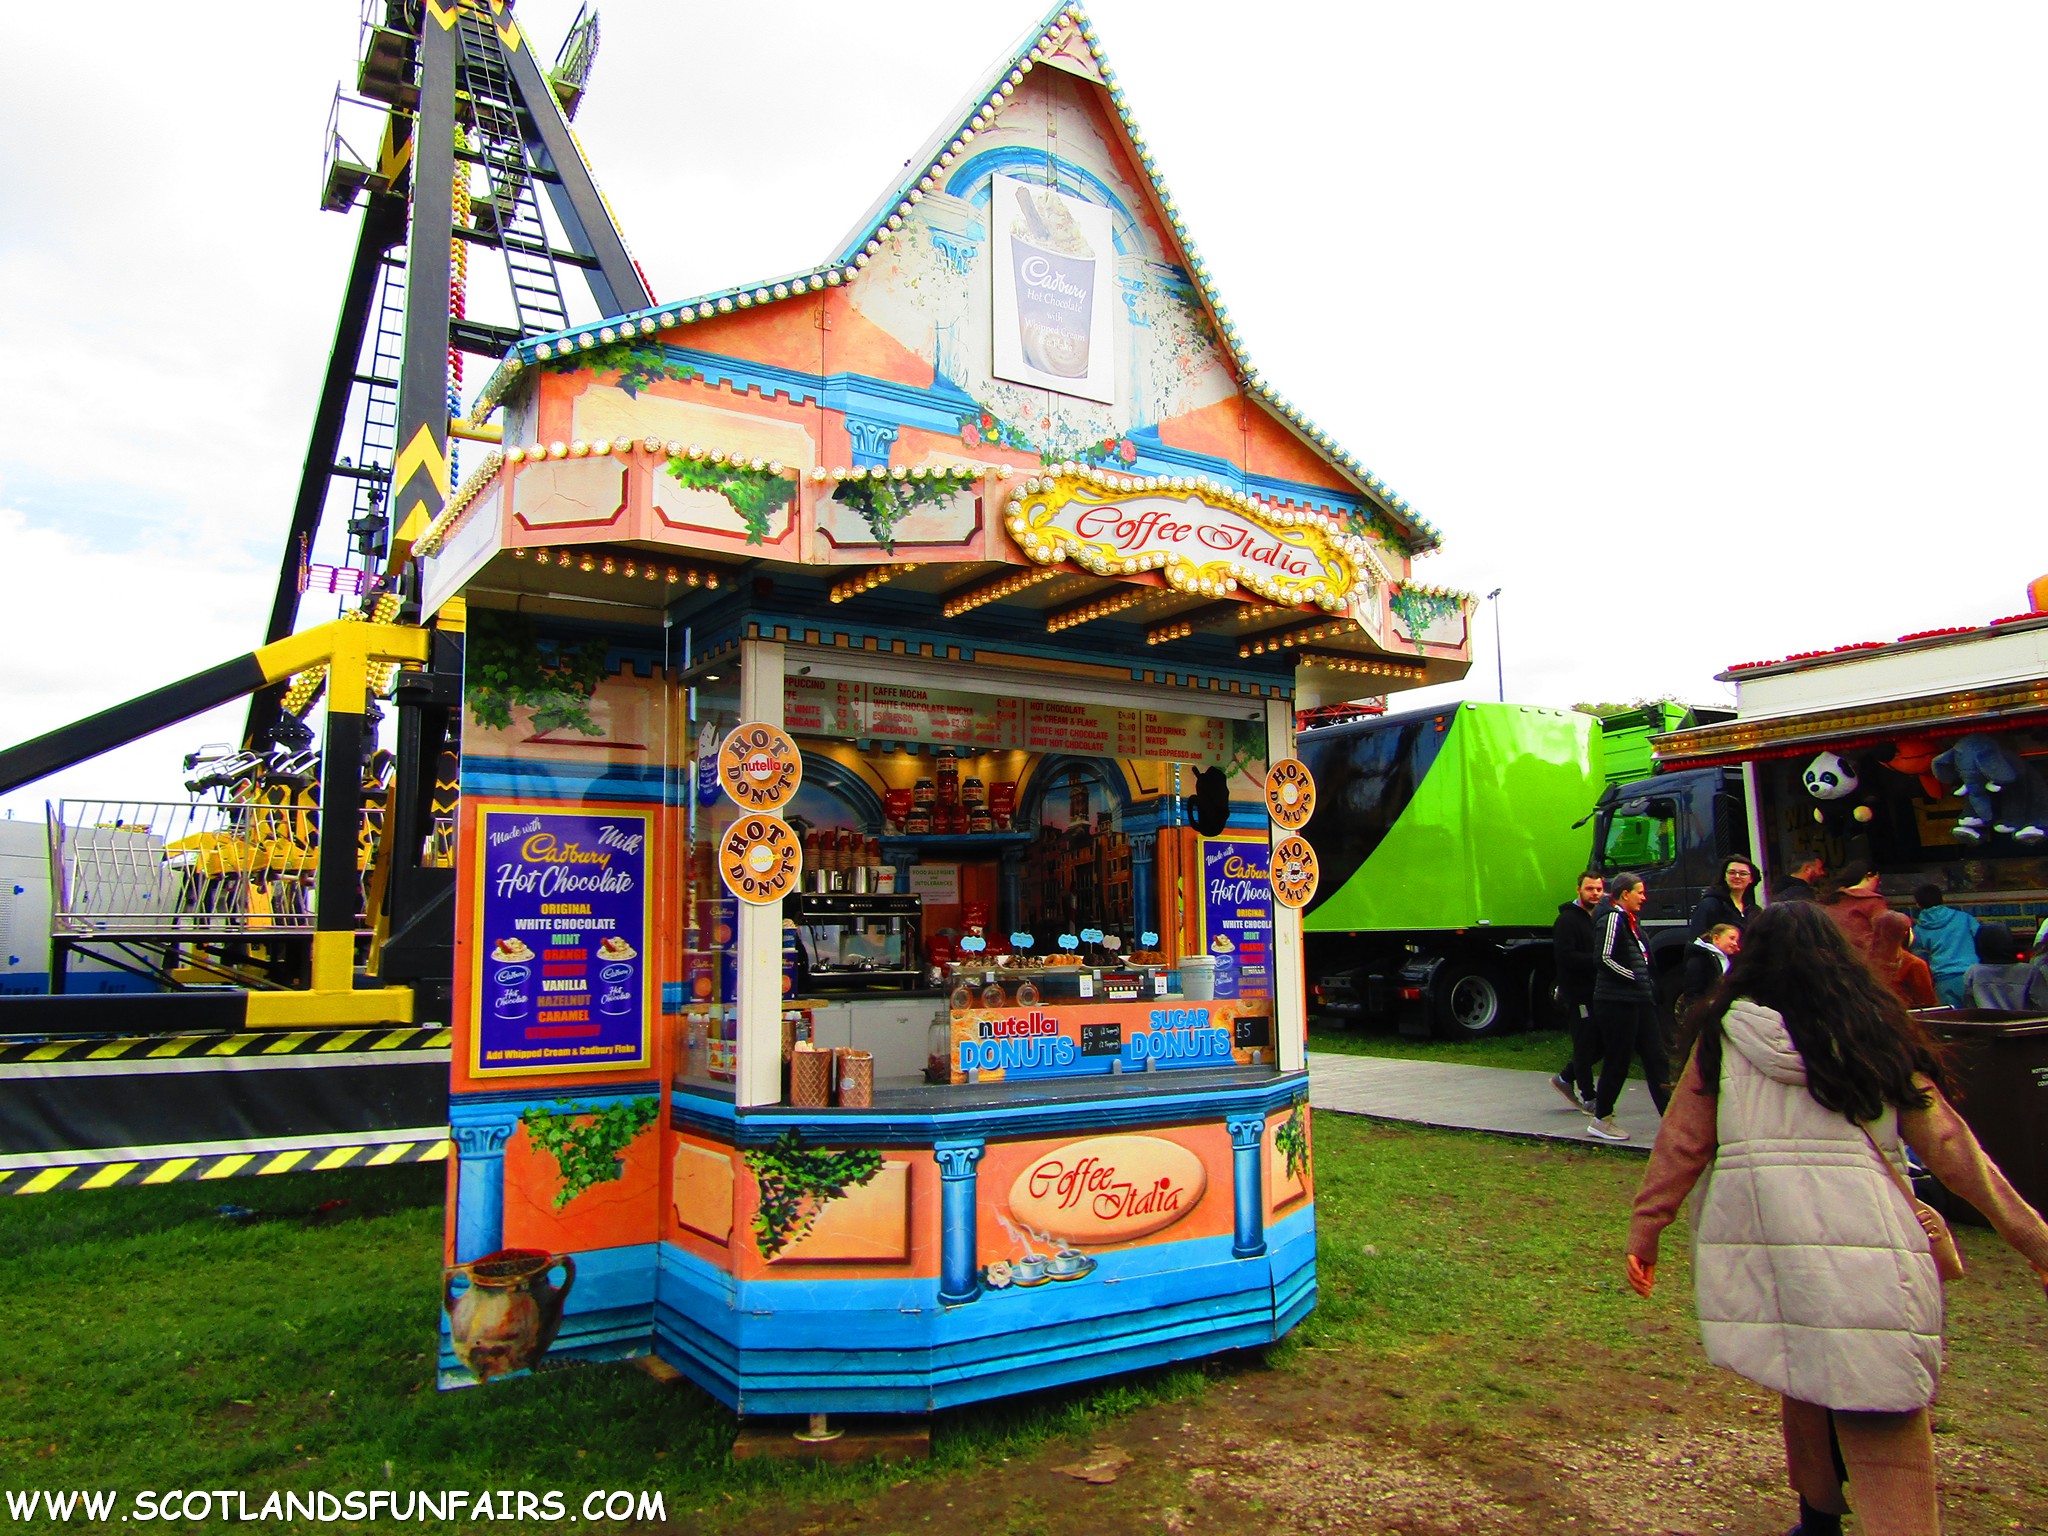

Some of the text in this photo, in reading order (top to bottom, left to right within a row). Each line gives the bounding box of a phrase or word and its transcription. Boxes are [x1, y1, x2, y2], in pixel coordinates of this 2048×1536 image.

[1021, 255, 1086, 304] Cadbury
[1027, 288, 1083, 313] Hot Chocolate
[1060, 327, 1085, 342] Cream
[1075, 506, 1313, 577] Coffee Italia
[873, 686, 928, 700] CAFFE MOCHA
[873, 699, 973, 716] WHITE CHOCOLATE MOCHA
[1030, 702, 1044, 712] HOT
[1045, 703, 1086, 715] CHOCOLATE
[872, 711, 913, 723] ESPRESSO
[1044, 714, 1070, 726] CREAM
[1076, 718, 1098, 728] FLAKE
[1145, 713, 1157, 723] TEA
[1030, 726, 1053, 736] WHITE
[1054, 727, 1068, 738] HOT
[1069, 728, 1109, 740] CHOCOLATE
[1145, 724, 1161, 735] COLD
[1161, 726, 1187, 737] DRINKS
[728, 728, 790, 761] HOT
[1029, 737, 1047, 747] MINT
[1048, 738, 1063, 749] HOT
[1064, 739, 1104, 751] CHOCOLATE
[1145, 736, 1168, 746] WATER
[1159, 749, 1189, 759] ESPRESSO
[741, 757, 781, 772] nutella
[726, 761, 796, 805] DONUTS
[1271, 764, 1309, 788] HOT
[1270, 790, 1311, 823] DONUTS
[489, 817, 542, 847] Made with
[598, 825, 643, 856] Milk
[727, 820, 786, 859] HOT
[521, 833, 612, 870] Cadbury
[1277, 842, 1313, 867] HOT
[729, 845, 796, 897] DONUTS
[496, 863, 634, 899] Hot Chocolate
[1275, 867, 1314, 901] DONUTS
[1210, 878, 1237, 905] Hot
[540, 903, 592, 915] ORIGINAL
[1236, 909, 1266, 917] ORIGINAL
[515, 918, 616, 930] WHITE CHOCOLATE
[1222, 920, 1243, 929] WHITE
[551, 933, 581, 945] MINT
[542, 979, 588, 991] VANILLA
[537, 994, 592, 1007] HAZELNUT
[538, 1010, 590, 1023] CARAMEL
[978, 1012, 1057, 1038] nutella
[1150, 1008, 1210, 1031] SUGAR
[1083, 1027, 1093, 1039] £6
[1236, 1022, 1251, 1039] £5
[1082, 1041, 1092, 1052] £7
[1130, 1028, 1231, 1060] DONUTS
[486, 1051, 503, 1060] Add
[504, 1048, 542, 1060] Whipped
[543, 1047, 571, 1057] Cream
[572, 1048, 579, 1056] &
[579, 1046, 613, 1056] Cadbury
[959, 1035, 1074, 1072] DONUTS
[1029, 1157, 1115, 1209] Coffee
[1093, 1177, 1184, 1220] Italia
